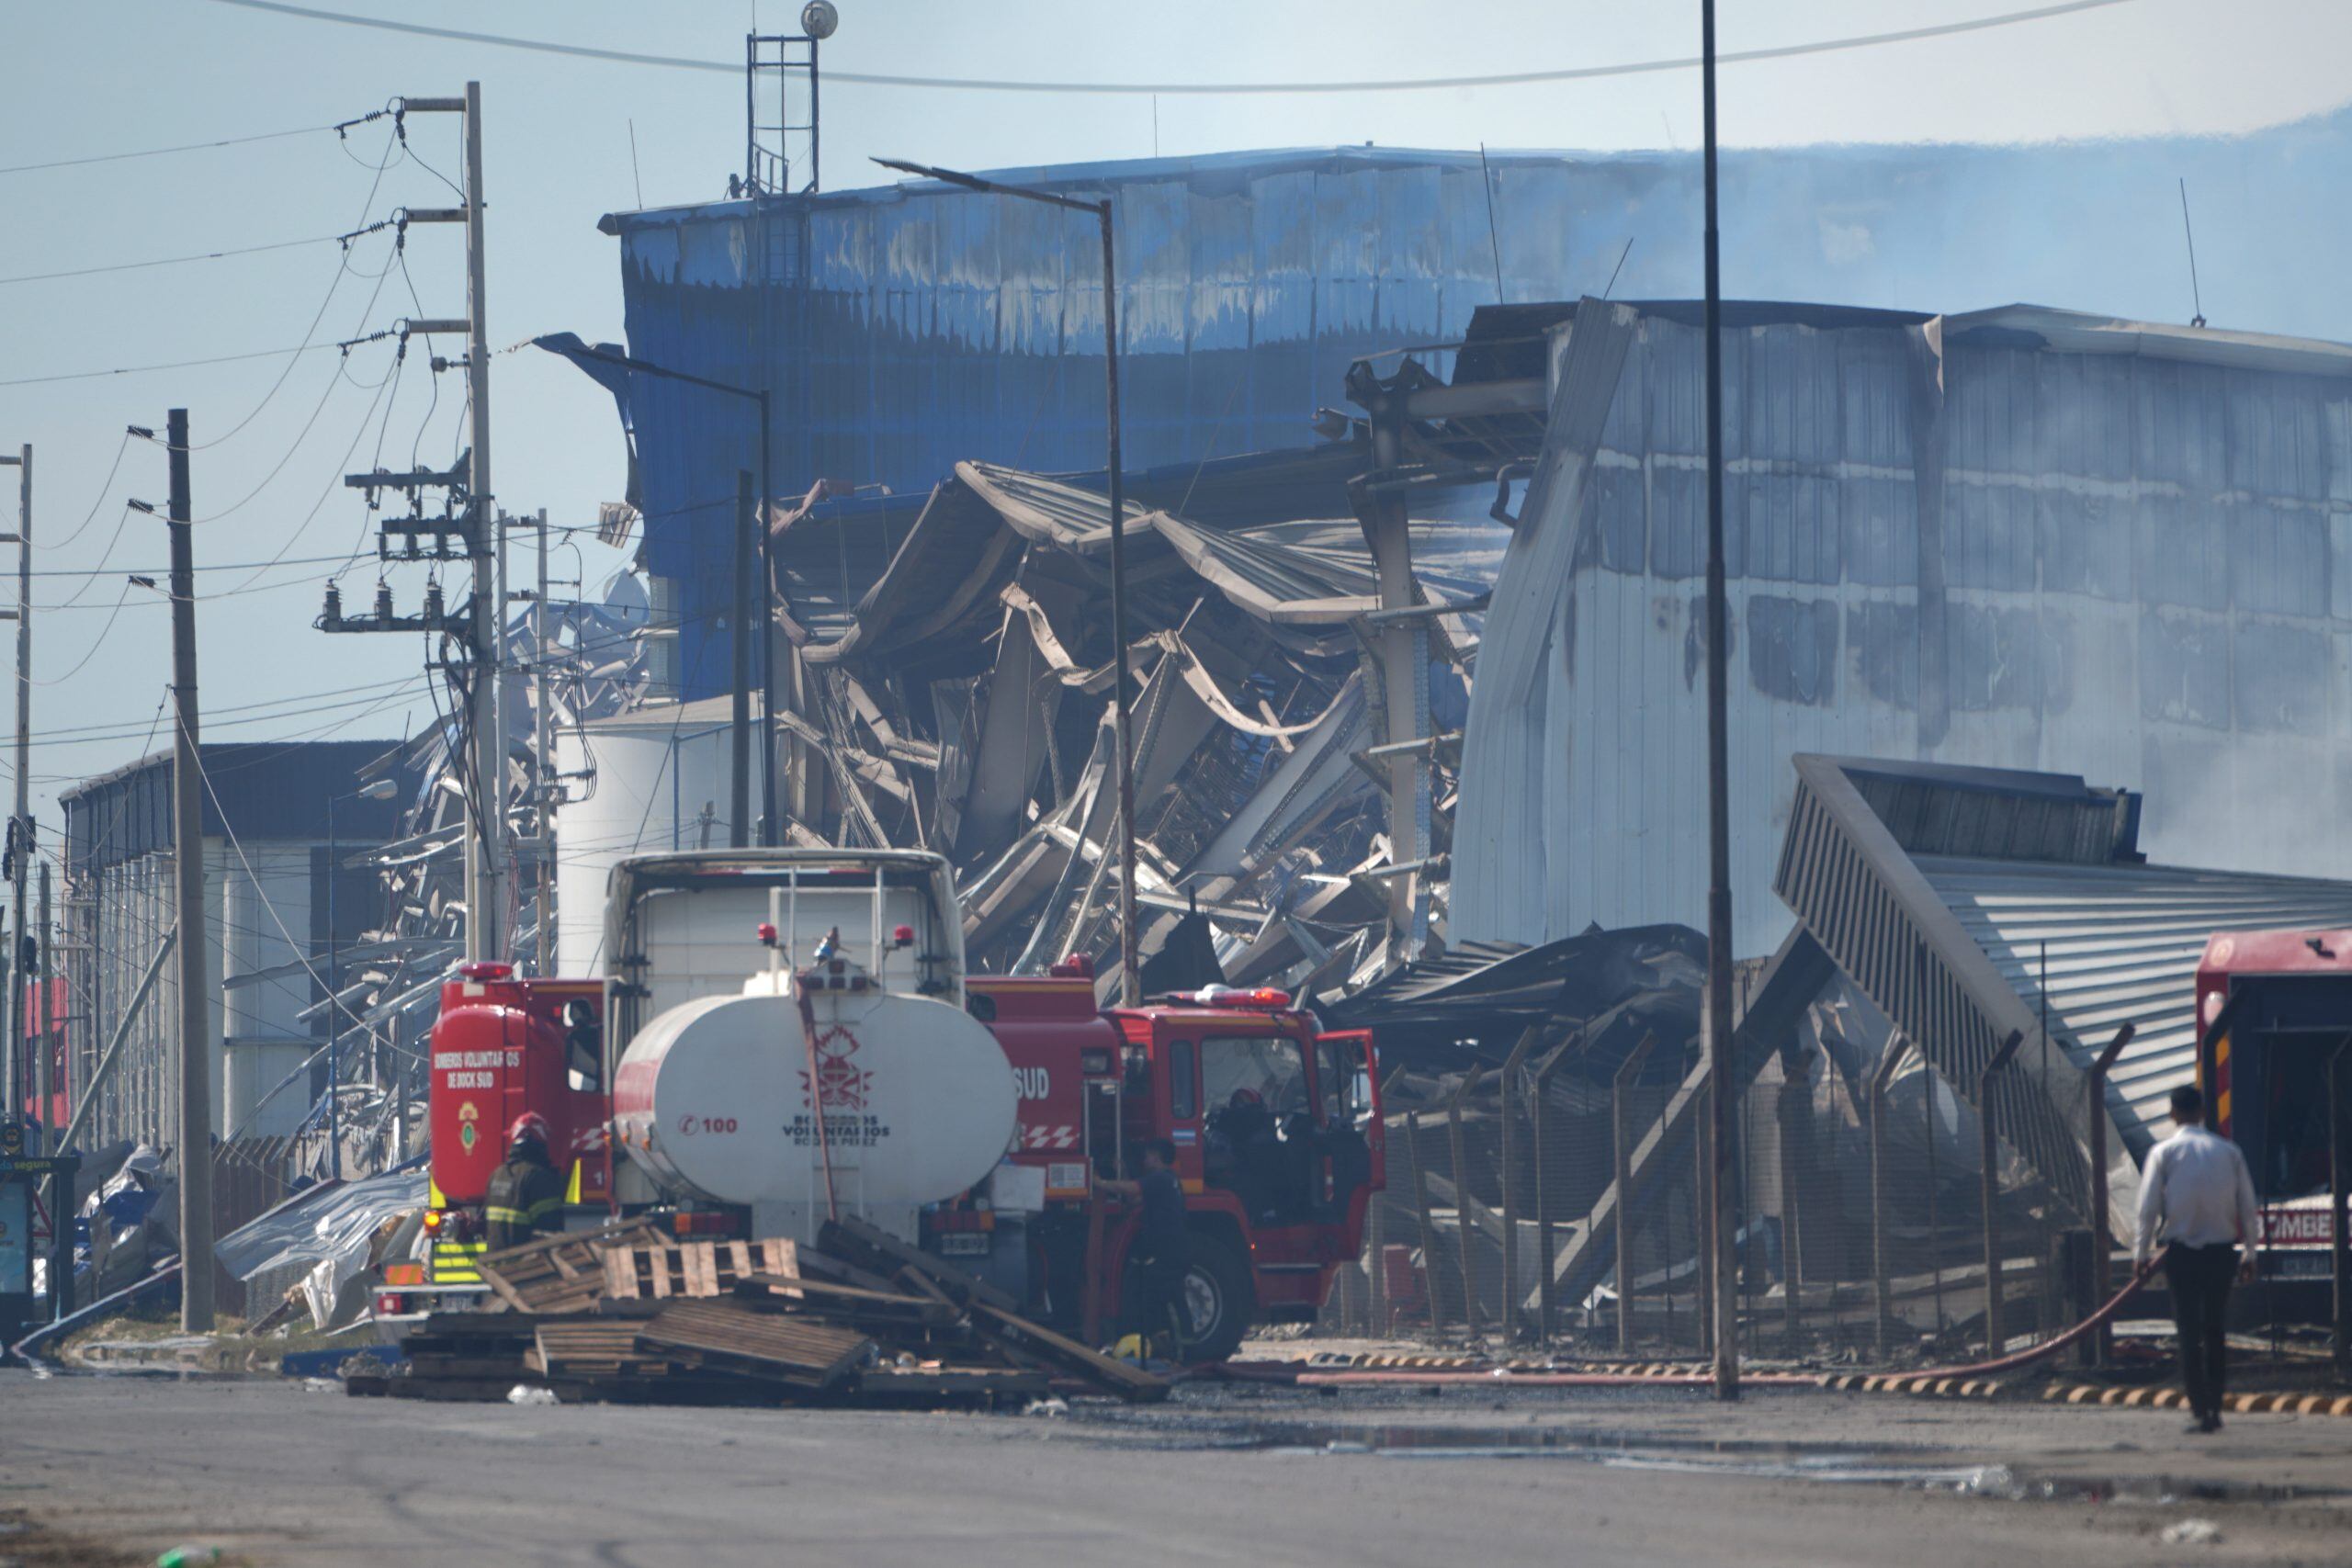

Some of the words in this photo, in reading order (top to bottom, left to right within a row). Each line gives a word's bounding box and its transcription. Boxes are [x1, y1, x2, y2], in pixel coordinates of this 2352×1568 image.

[435, 1052, 462, 1069] BOMBEROS
[464, 1051, 520, 1068] VOLUNTAROS
[447, 1071, 457, 1089] DE
[458, 1071, 476, 1089] DOCK
[476, 1071, 494, 1089] SUD
[1013, 1066, 1050, 1100] SUD
[702, 1118, 738, 1134] 100
